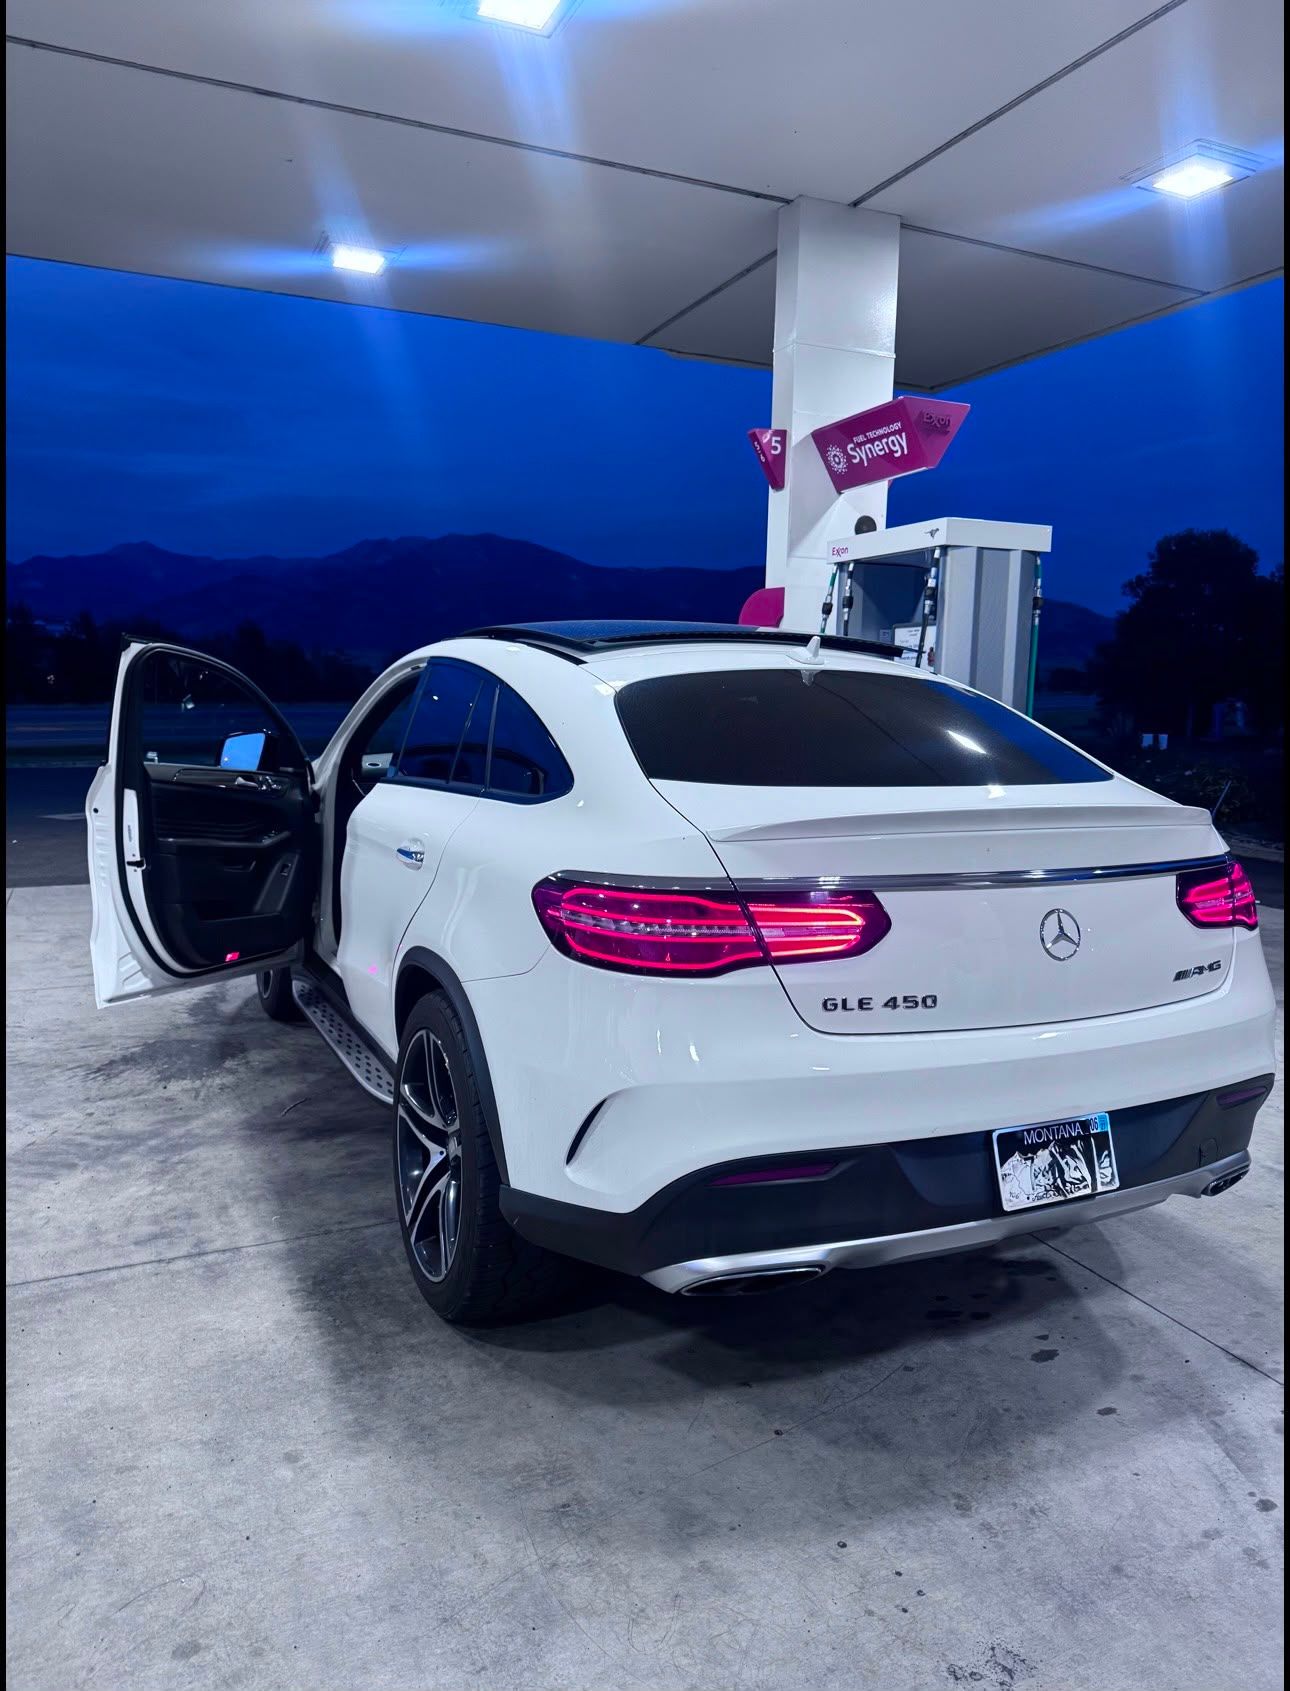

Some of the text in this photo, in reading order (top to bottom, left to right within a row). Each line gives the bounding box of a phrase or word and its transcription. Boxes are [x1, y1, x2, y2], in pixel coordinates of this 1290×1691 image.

[853, 421, 902, 444] FUEL TECHNOLOGY
[771, 436, 781, 455] 5
[847, 432, 908, 467] Synergy
[832, 546, 849, 558] Exxon
[822, 994, 938, 1012] GLE 450
[1023, 1121, 1084, 1145] MONTANA
[1090, 1116, 1098, 1131] 06
